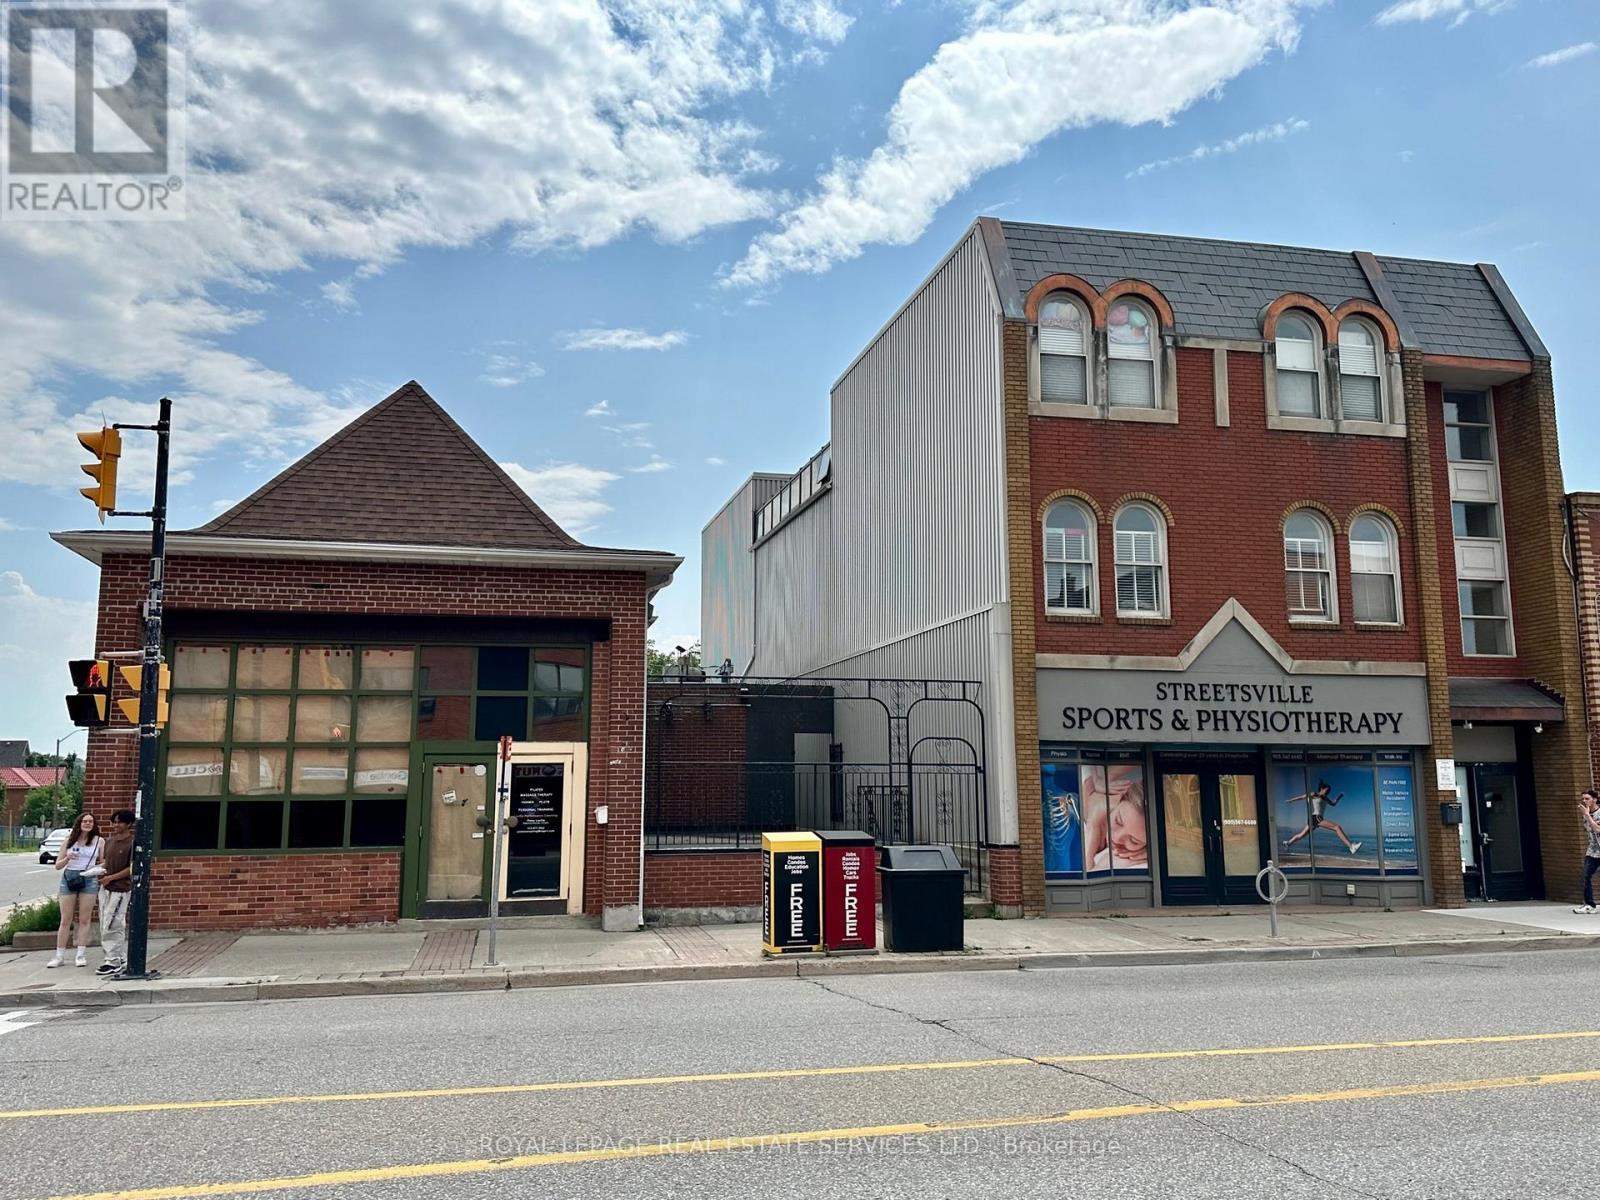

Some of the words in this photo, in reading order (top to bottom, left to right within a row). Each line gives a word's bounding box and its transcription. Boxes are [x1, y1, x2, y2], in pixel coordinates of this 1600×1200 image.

[1156, 682, 1314, 703] STREETSVILLE
[1062, 707, 1163, 730] SPORTS
[1171, 709, 1190, 731] &
[1196, 710, 1403, 734] PHYSIOTHERAPY
[790, 883, 804, 937] FREE
[845, 883, 858, 937] FREE
